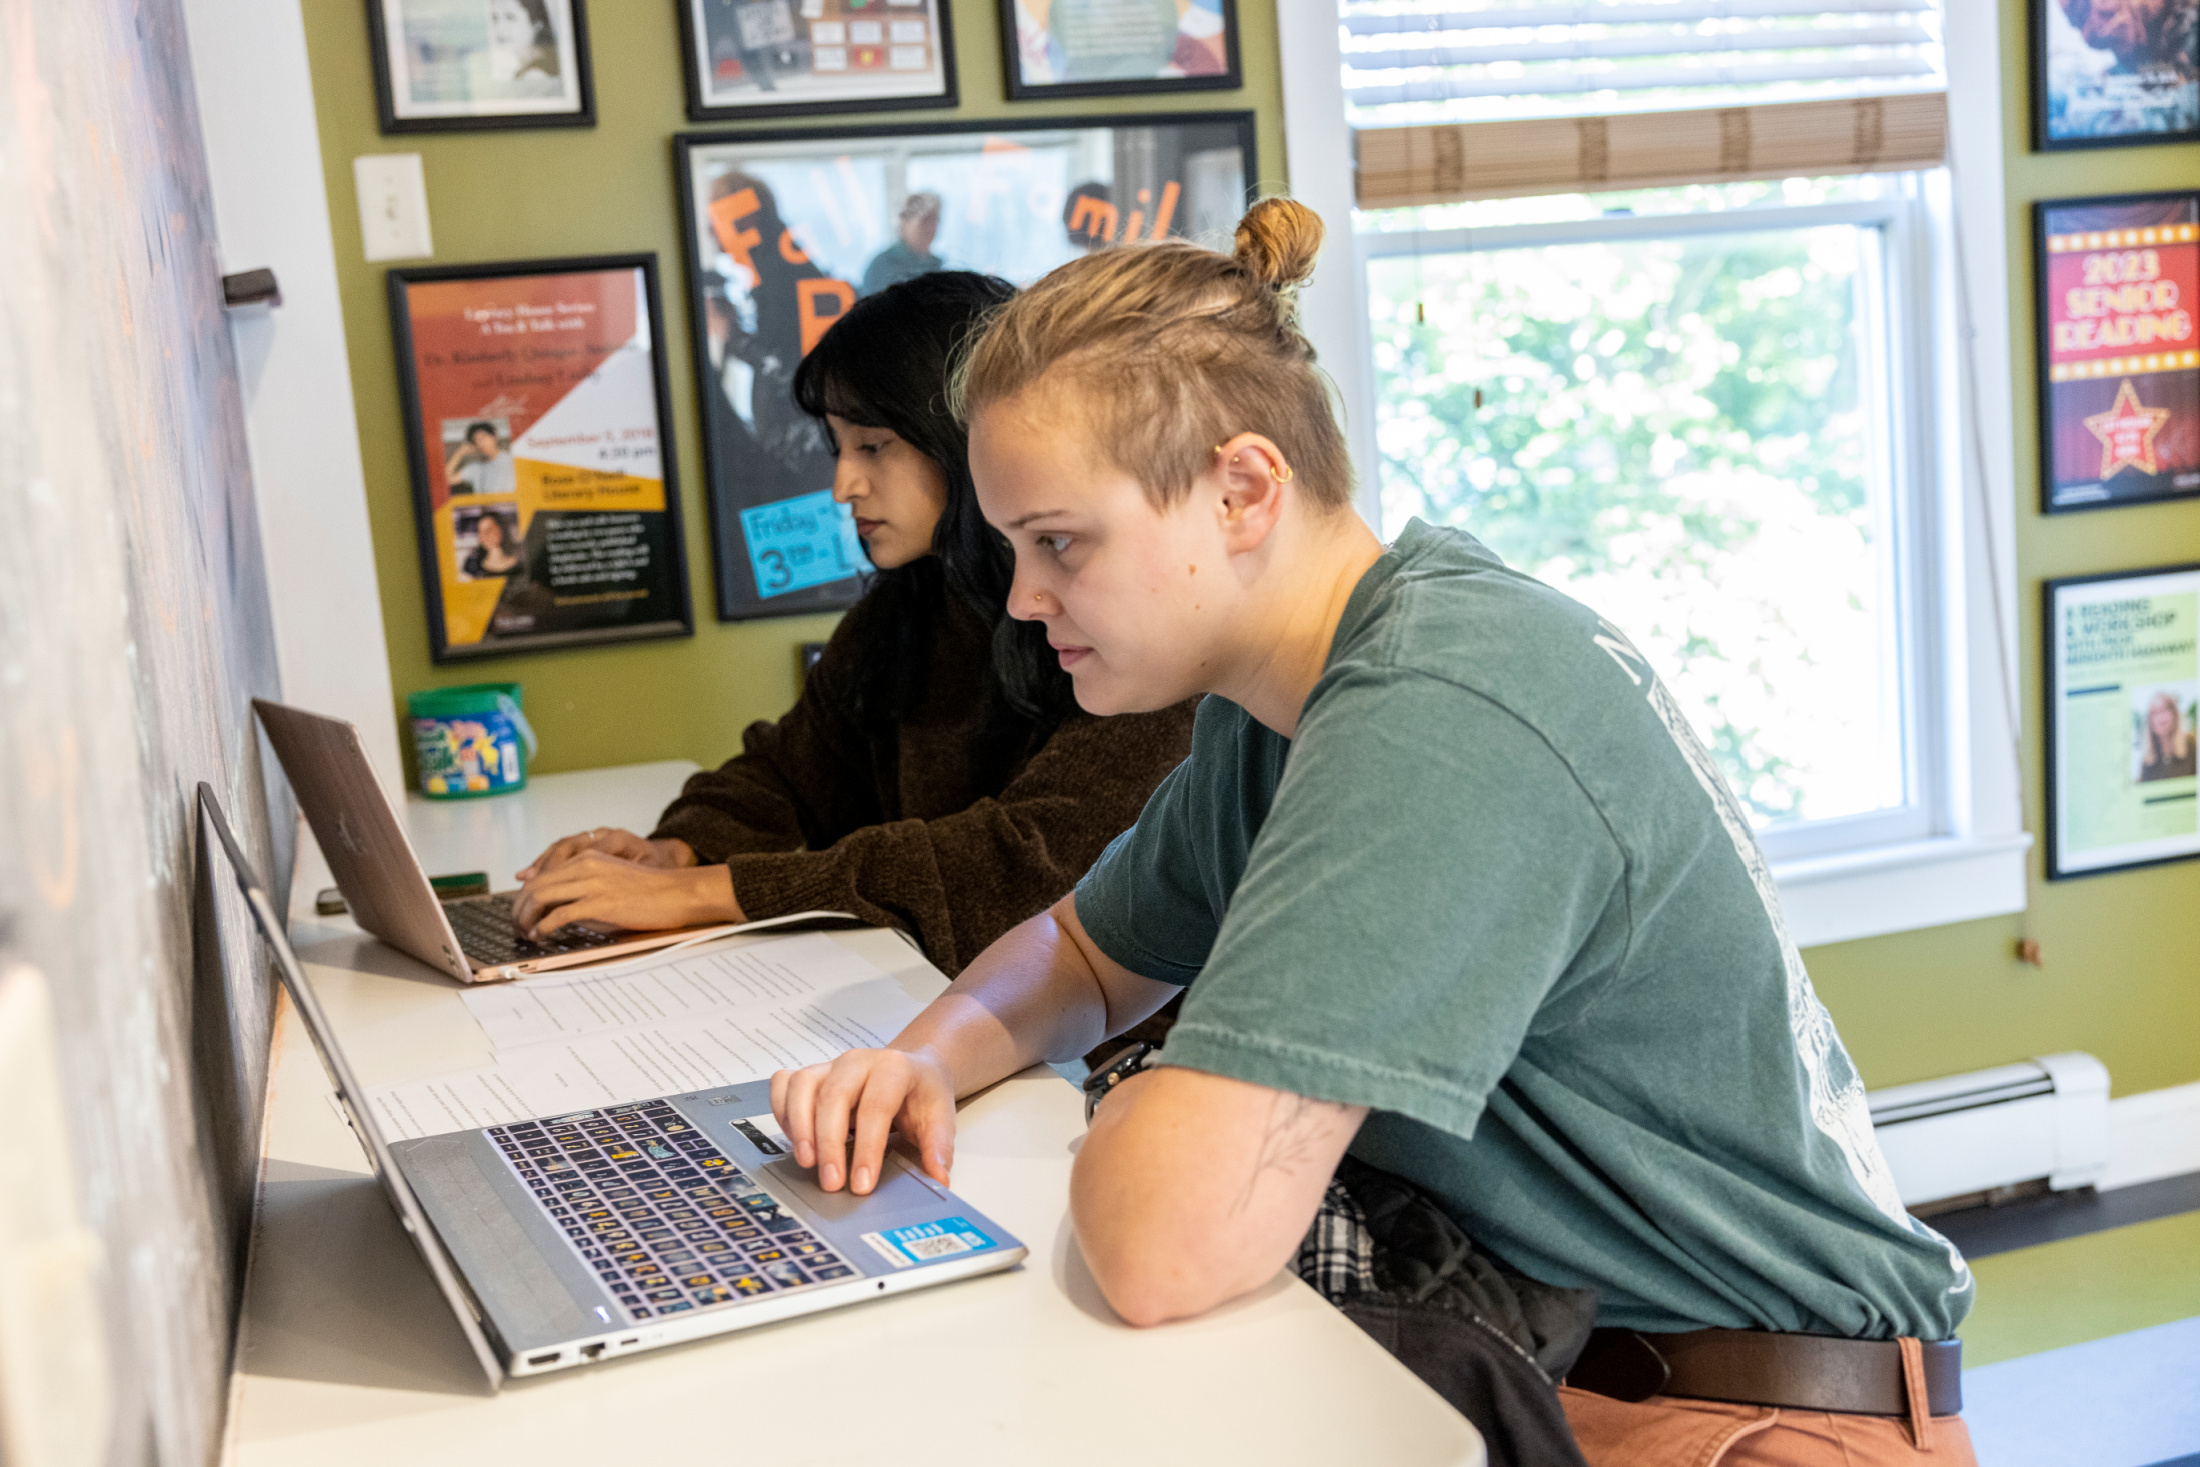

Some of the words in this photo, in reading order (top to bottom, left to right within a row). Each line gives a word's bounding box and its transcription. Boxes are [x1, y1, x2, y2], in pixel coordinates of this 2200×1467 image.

[966, 135, 1183, 245] Famil
[2082, 249, 2161, 285] 2023
[2065, 279, 2180, 320] SENIOR
[2053, 309, 2192, 352] READING
[527, 432, 600, 448] September
[542, 472, 573, 485] Rose
[544, 486, 593, 502] Literary
[598, 484, 641, 495] House
[748, 505, 820, 541] Friday
[2081, 597, 2151, 617] READING
[2082, 609, 2177, 634] WORKSHOP
